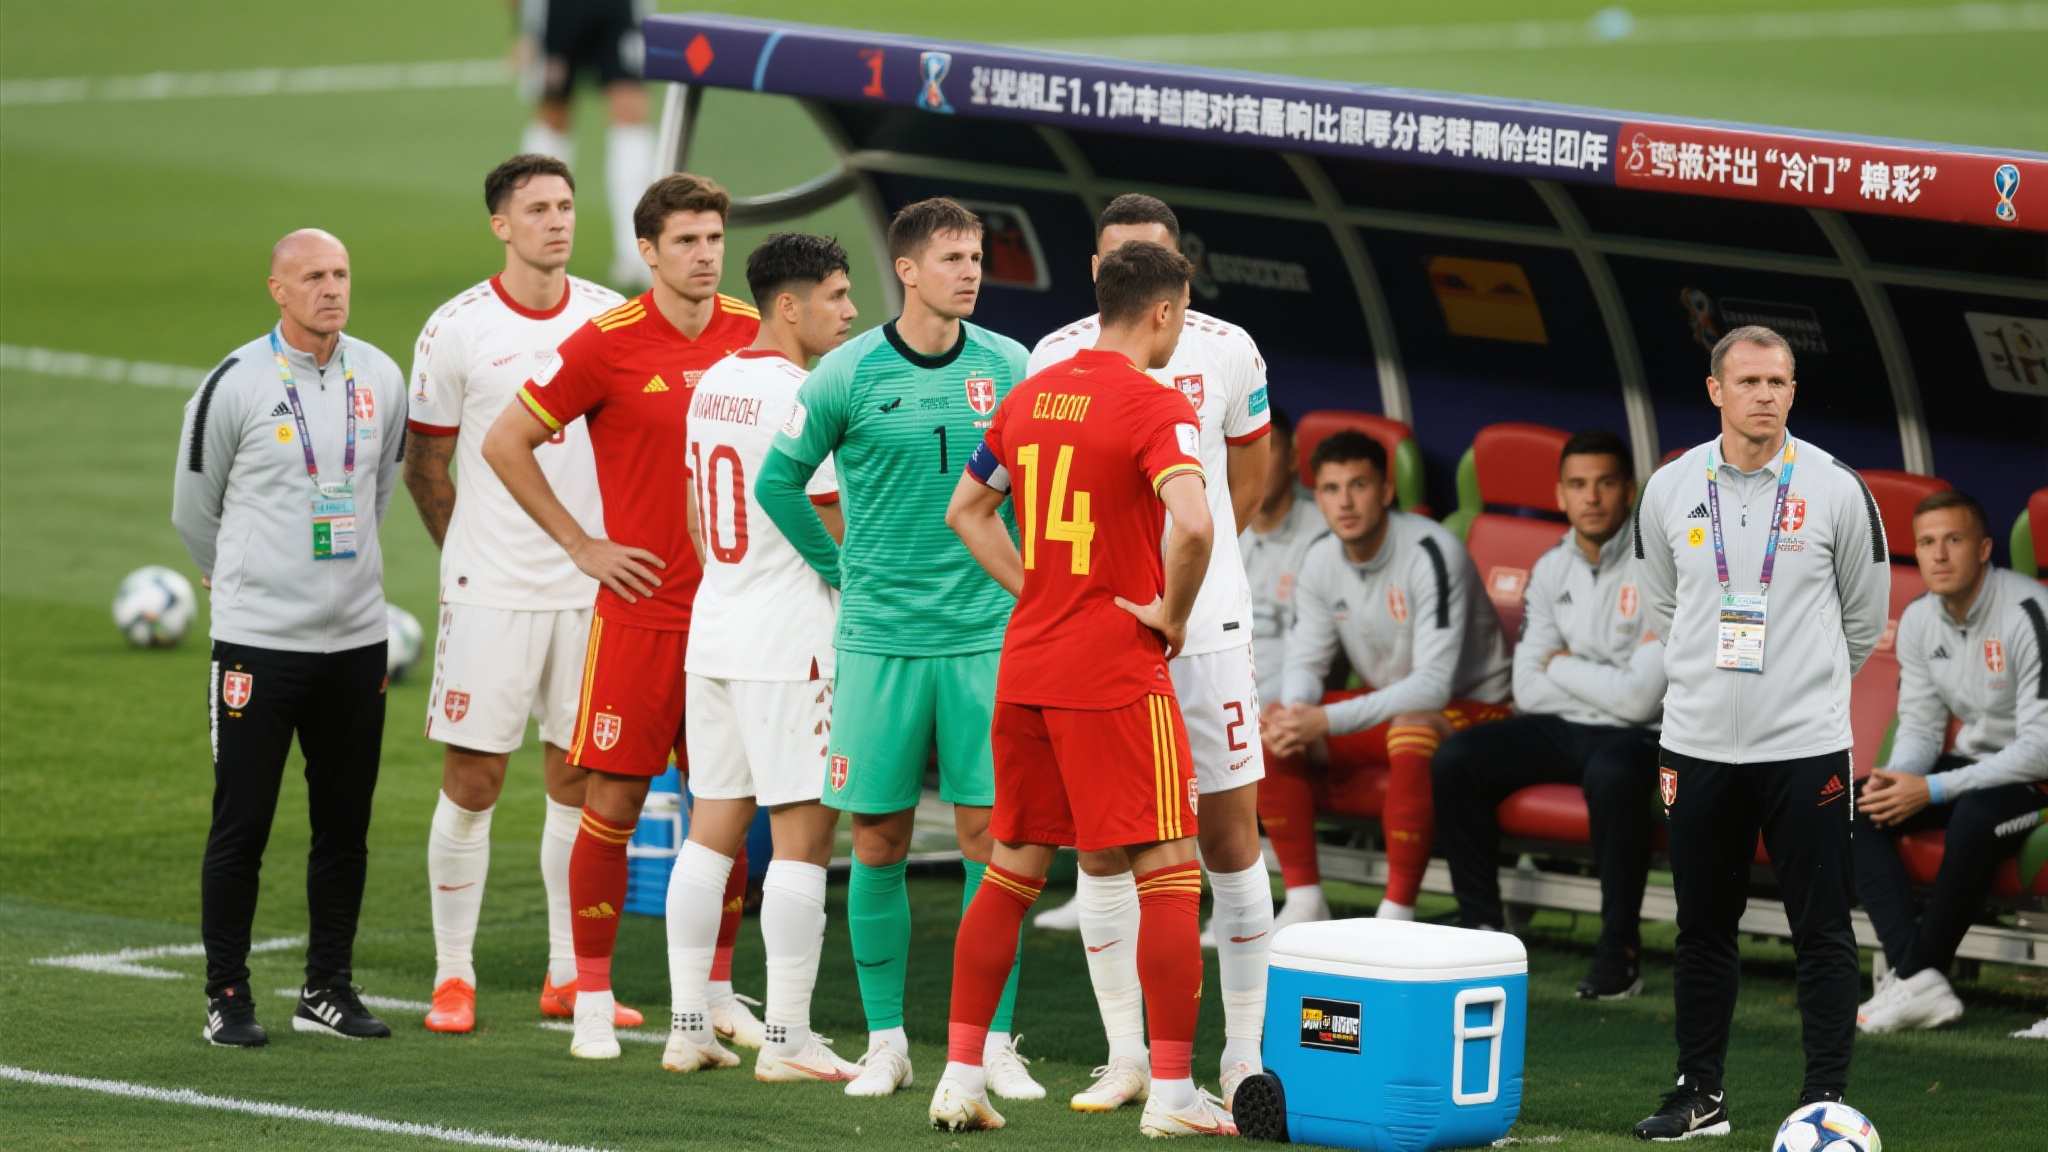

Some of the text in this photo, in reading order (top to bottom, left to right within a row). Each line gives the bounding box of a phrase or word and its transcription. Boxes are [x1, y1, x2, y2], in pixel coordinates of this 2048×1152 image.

[932, 425, 949, 474] 1
[691, 441, 748, 564] 10
[1017, 443, 1096, 576] 14
[1223, 701, 1248, 752] 2
